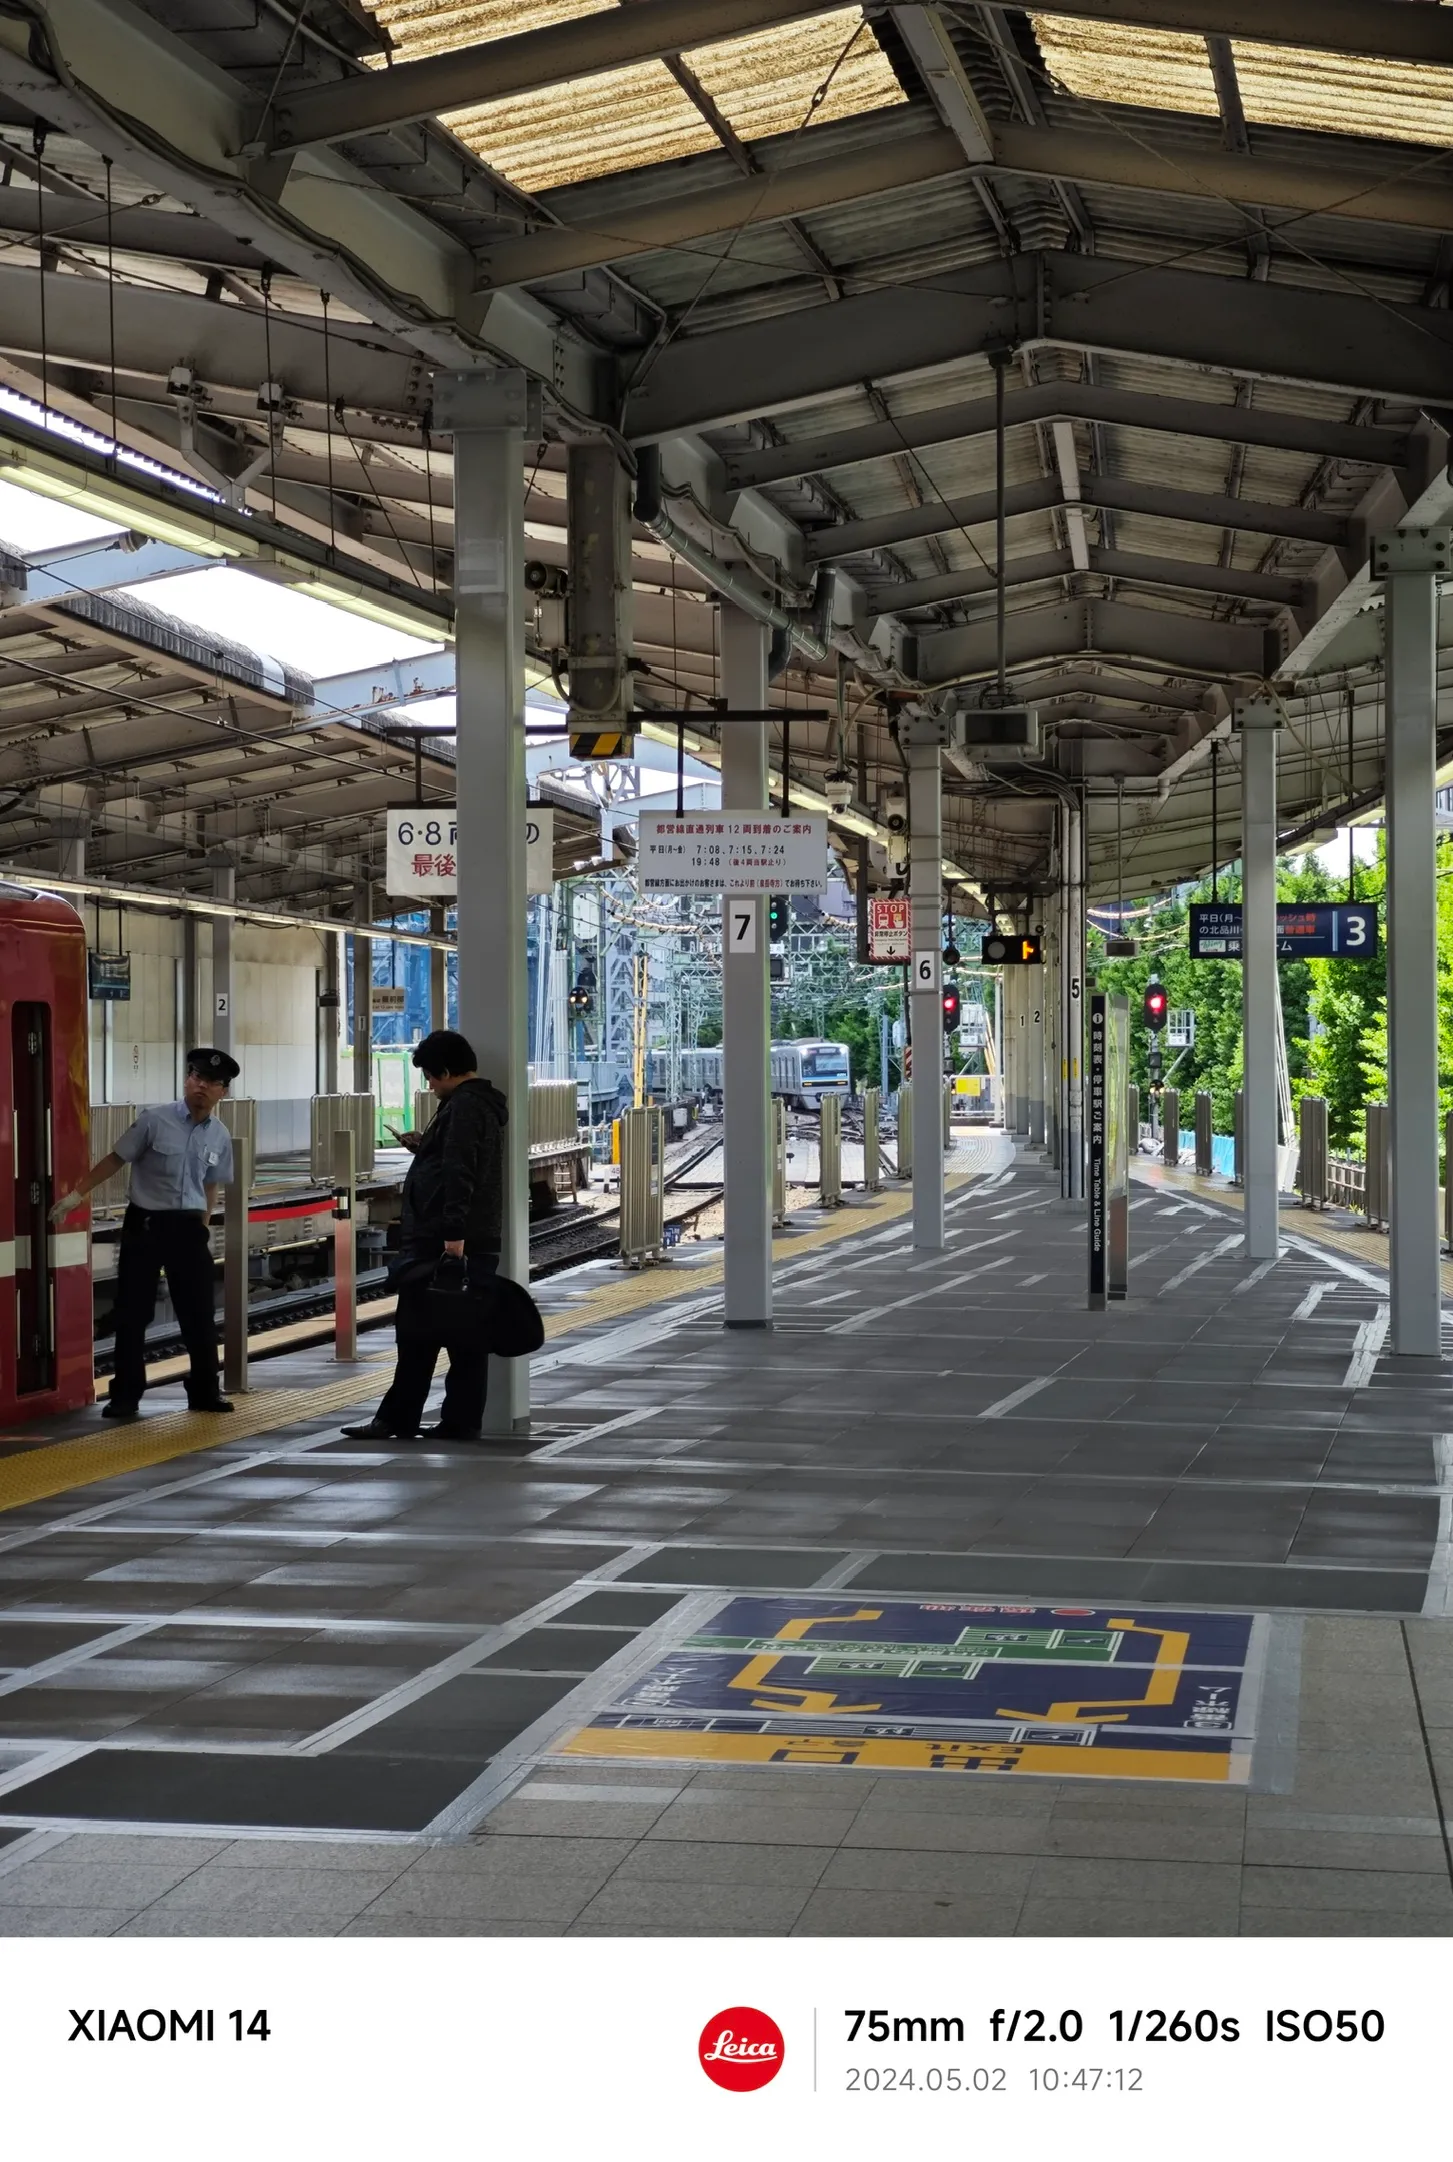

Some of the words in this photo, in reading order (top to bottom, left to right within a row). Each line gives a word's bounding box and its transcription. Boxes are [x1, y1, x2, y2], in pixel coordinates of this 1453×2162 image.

[411, 853, 457, 877] 最後
[691, 857, 720, 866] 19:48
[877, 904, 904, 913] STOP
[735, 914, 751, 941] 7
[1346, 916, 1367, 946] 3
[919, 959, 931, 980] 6
[1072, 978, 1080, 998] 5
[218, 998, 226, 1011] 2
[1020, 1016, 1024, 1026] 1
[1034, 1011, 1040, 1022] 2
[1093, 1158, 1102, 1177] Time
[1093, 1178, 1102, 1199] Table
[1093, 1228, 1102, 1252] Guide
[926, 1743, 1025, 1755] Exit
